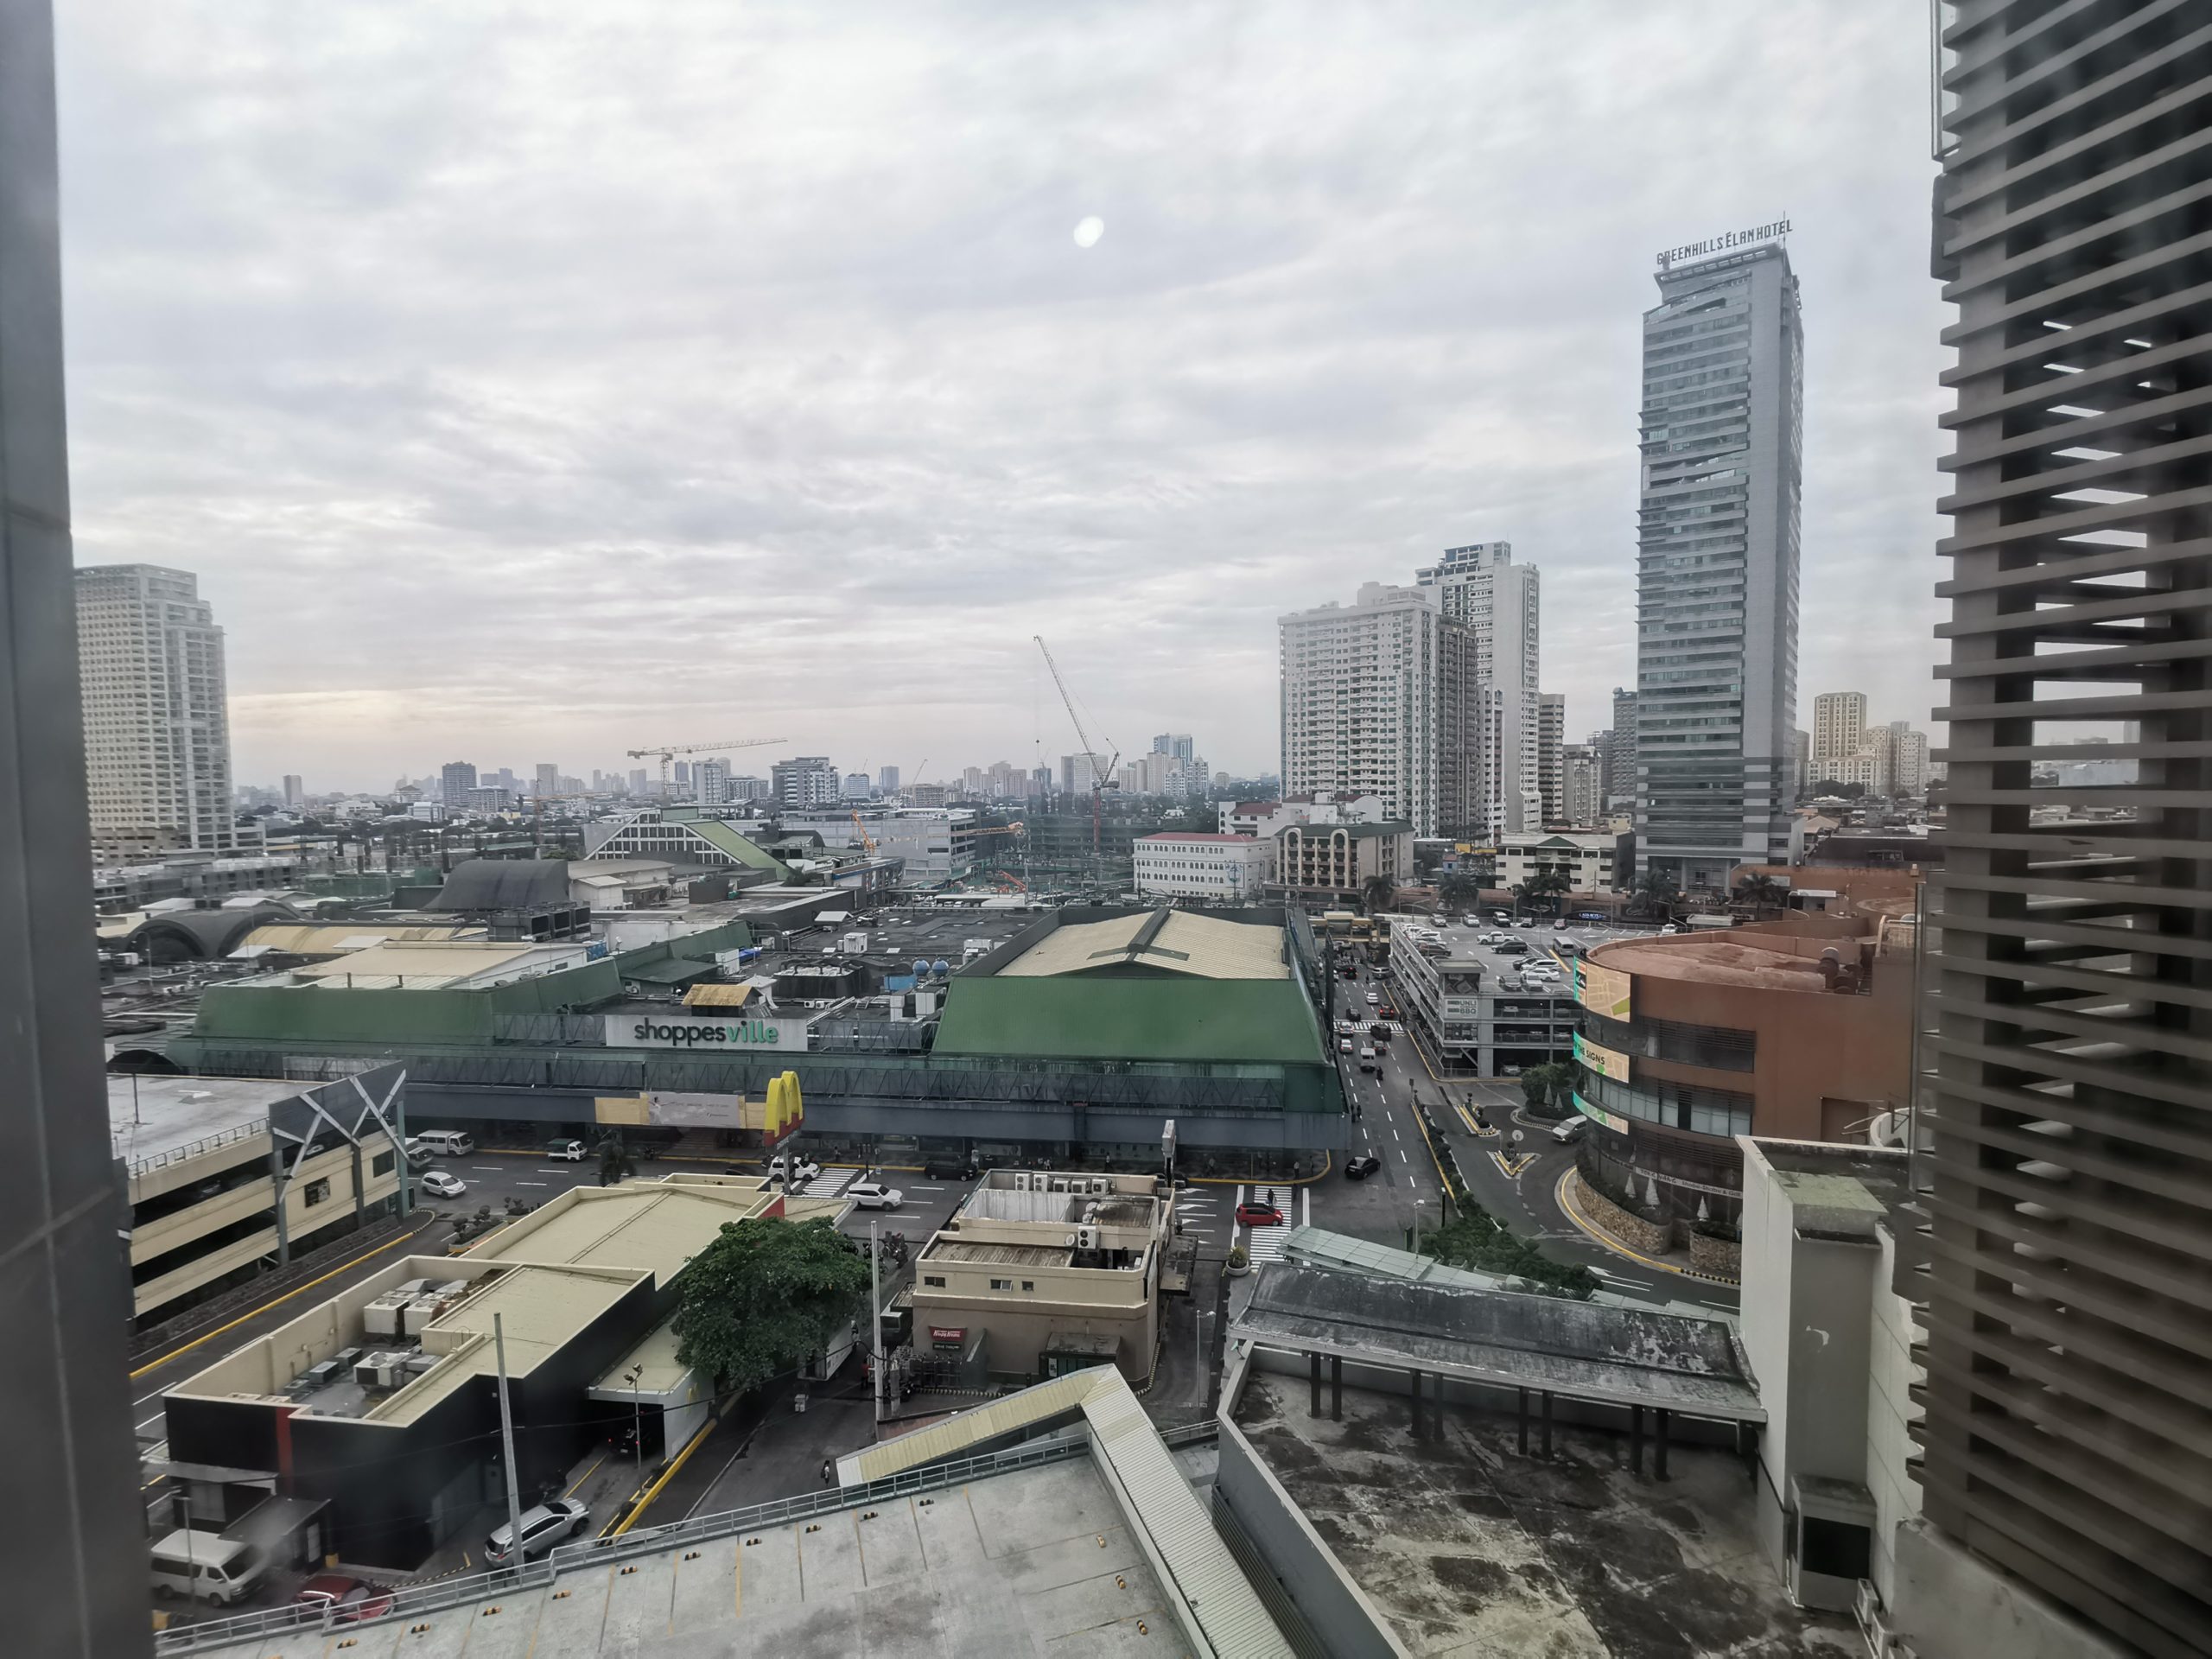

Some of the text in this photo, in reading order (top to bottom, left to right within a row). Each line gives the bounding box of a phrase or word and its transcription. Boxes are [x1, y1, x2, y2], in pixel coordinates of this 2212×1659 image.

[1726, 230, 1755, 248] ÉLAN
[1757, 219, 1793, 239] HOTEL
[634, 1017, 778, 1046] shoppesville
[1586, 1050, 1605, 1065] SIGNS
